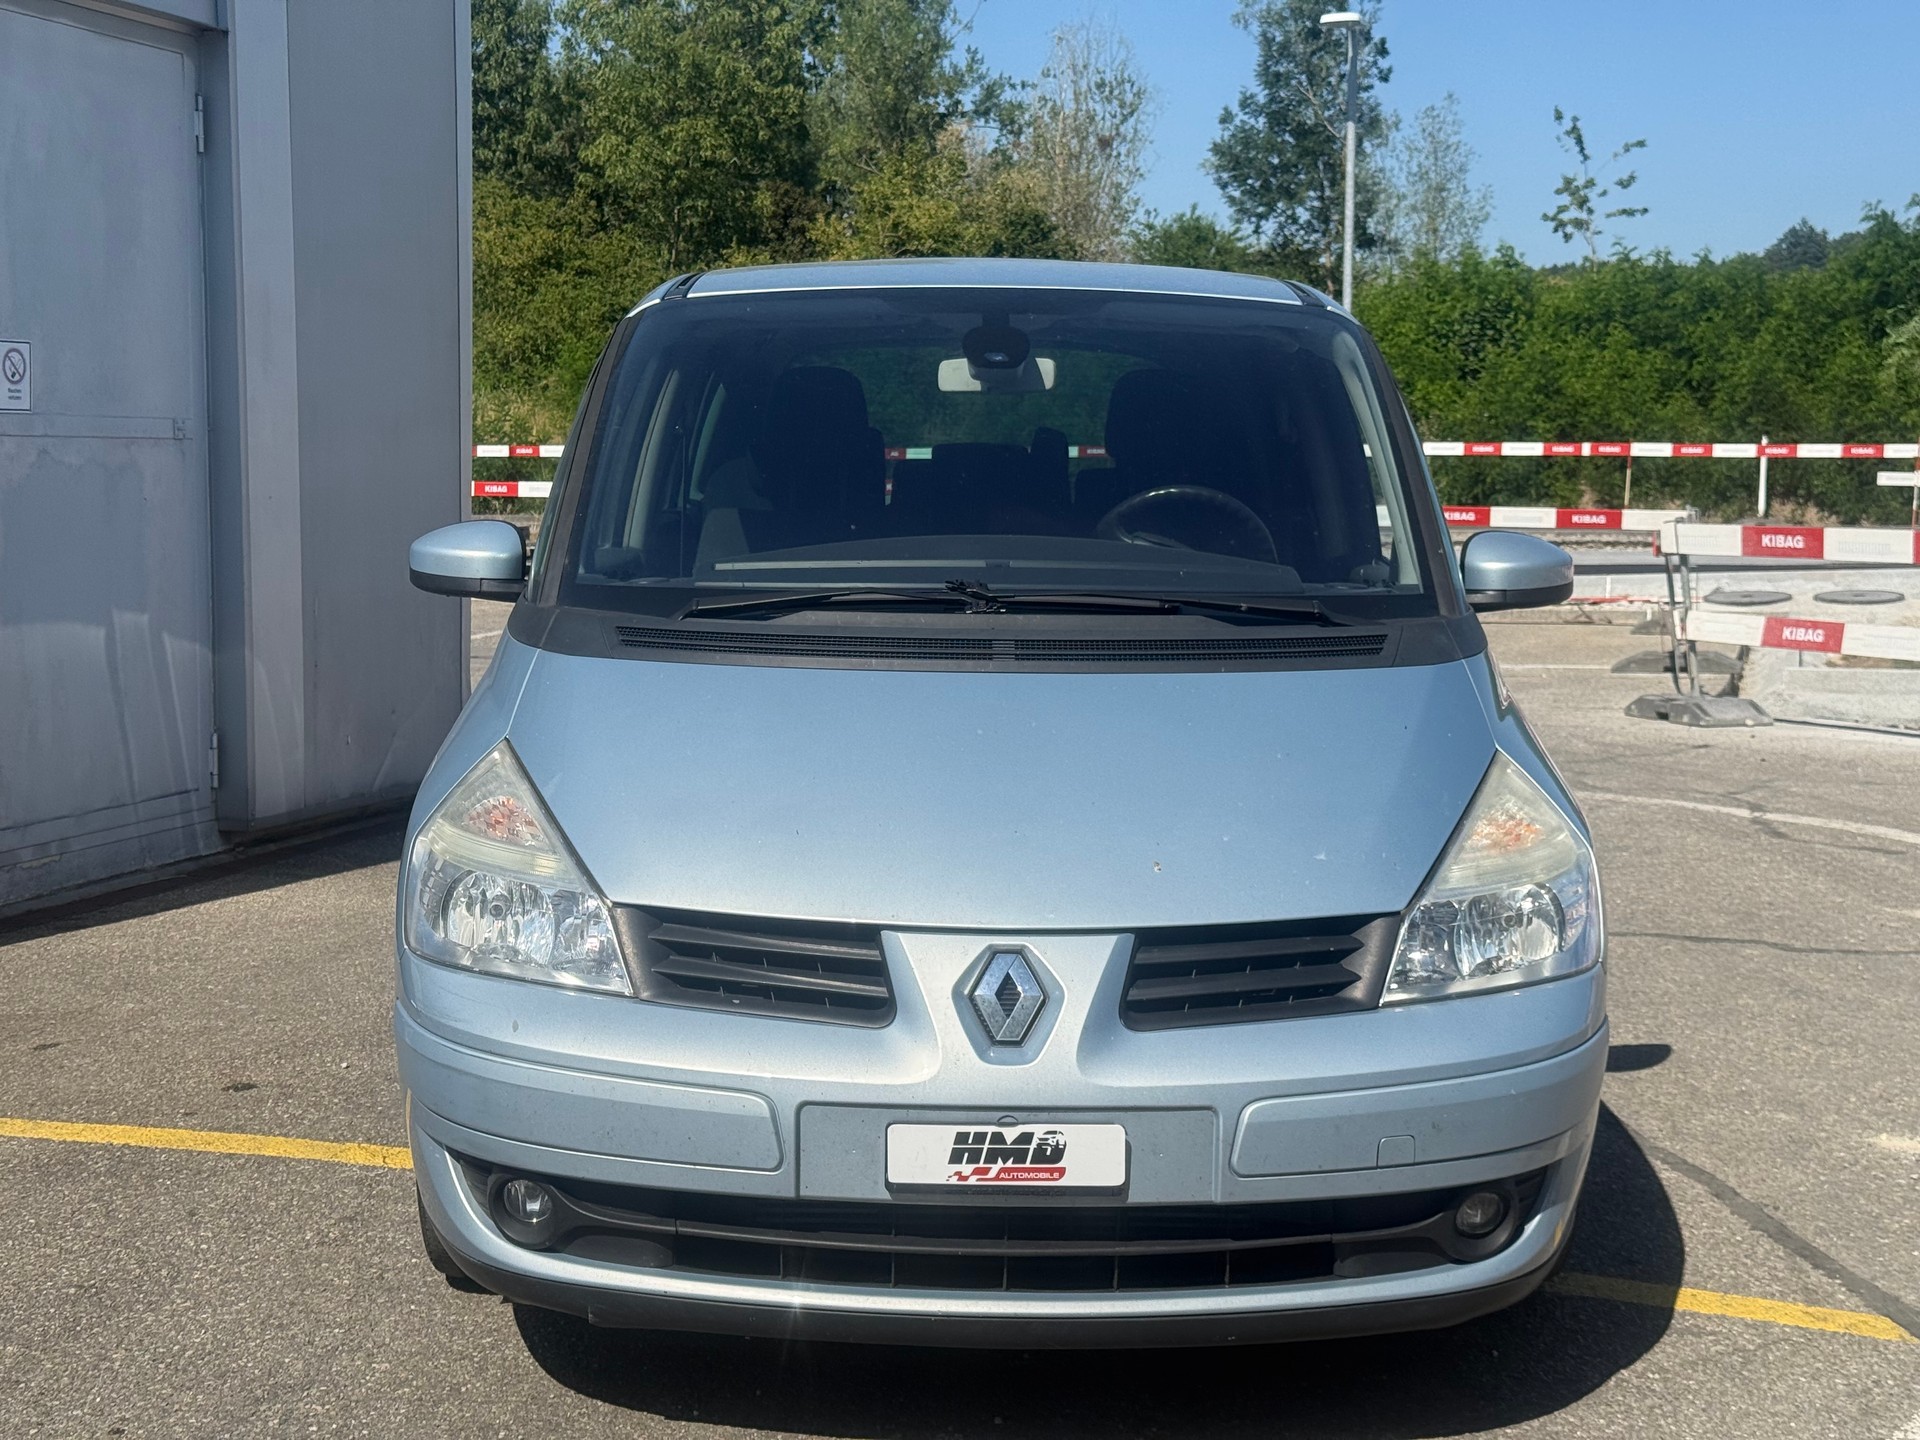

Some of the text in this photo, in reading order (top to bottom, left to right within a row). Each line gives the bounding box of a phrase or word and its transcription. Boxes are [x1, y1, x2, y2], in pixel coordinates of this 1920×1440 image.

[484, 485, 508, 493] KIBAG
[1443, 511, 1476, 520] KIBAG
[1571, 514, 1607, 524] KIBAG
[1761, 534, 1805, 549] KIBAG
[1782, 626, 1825, 643] KIBAG
[947, 1130, 1067, 1165] HMD
